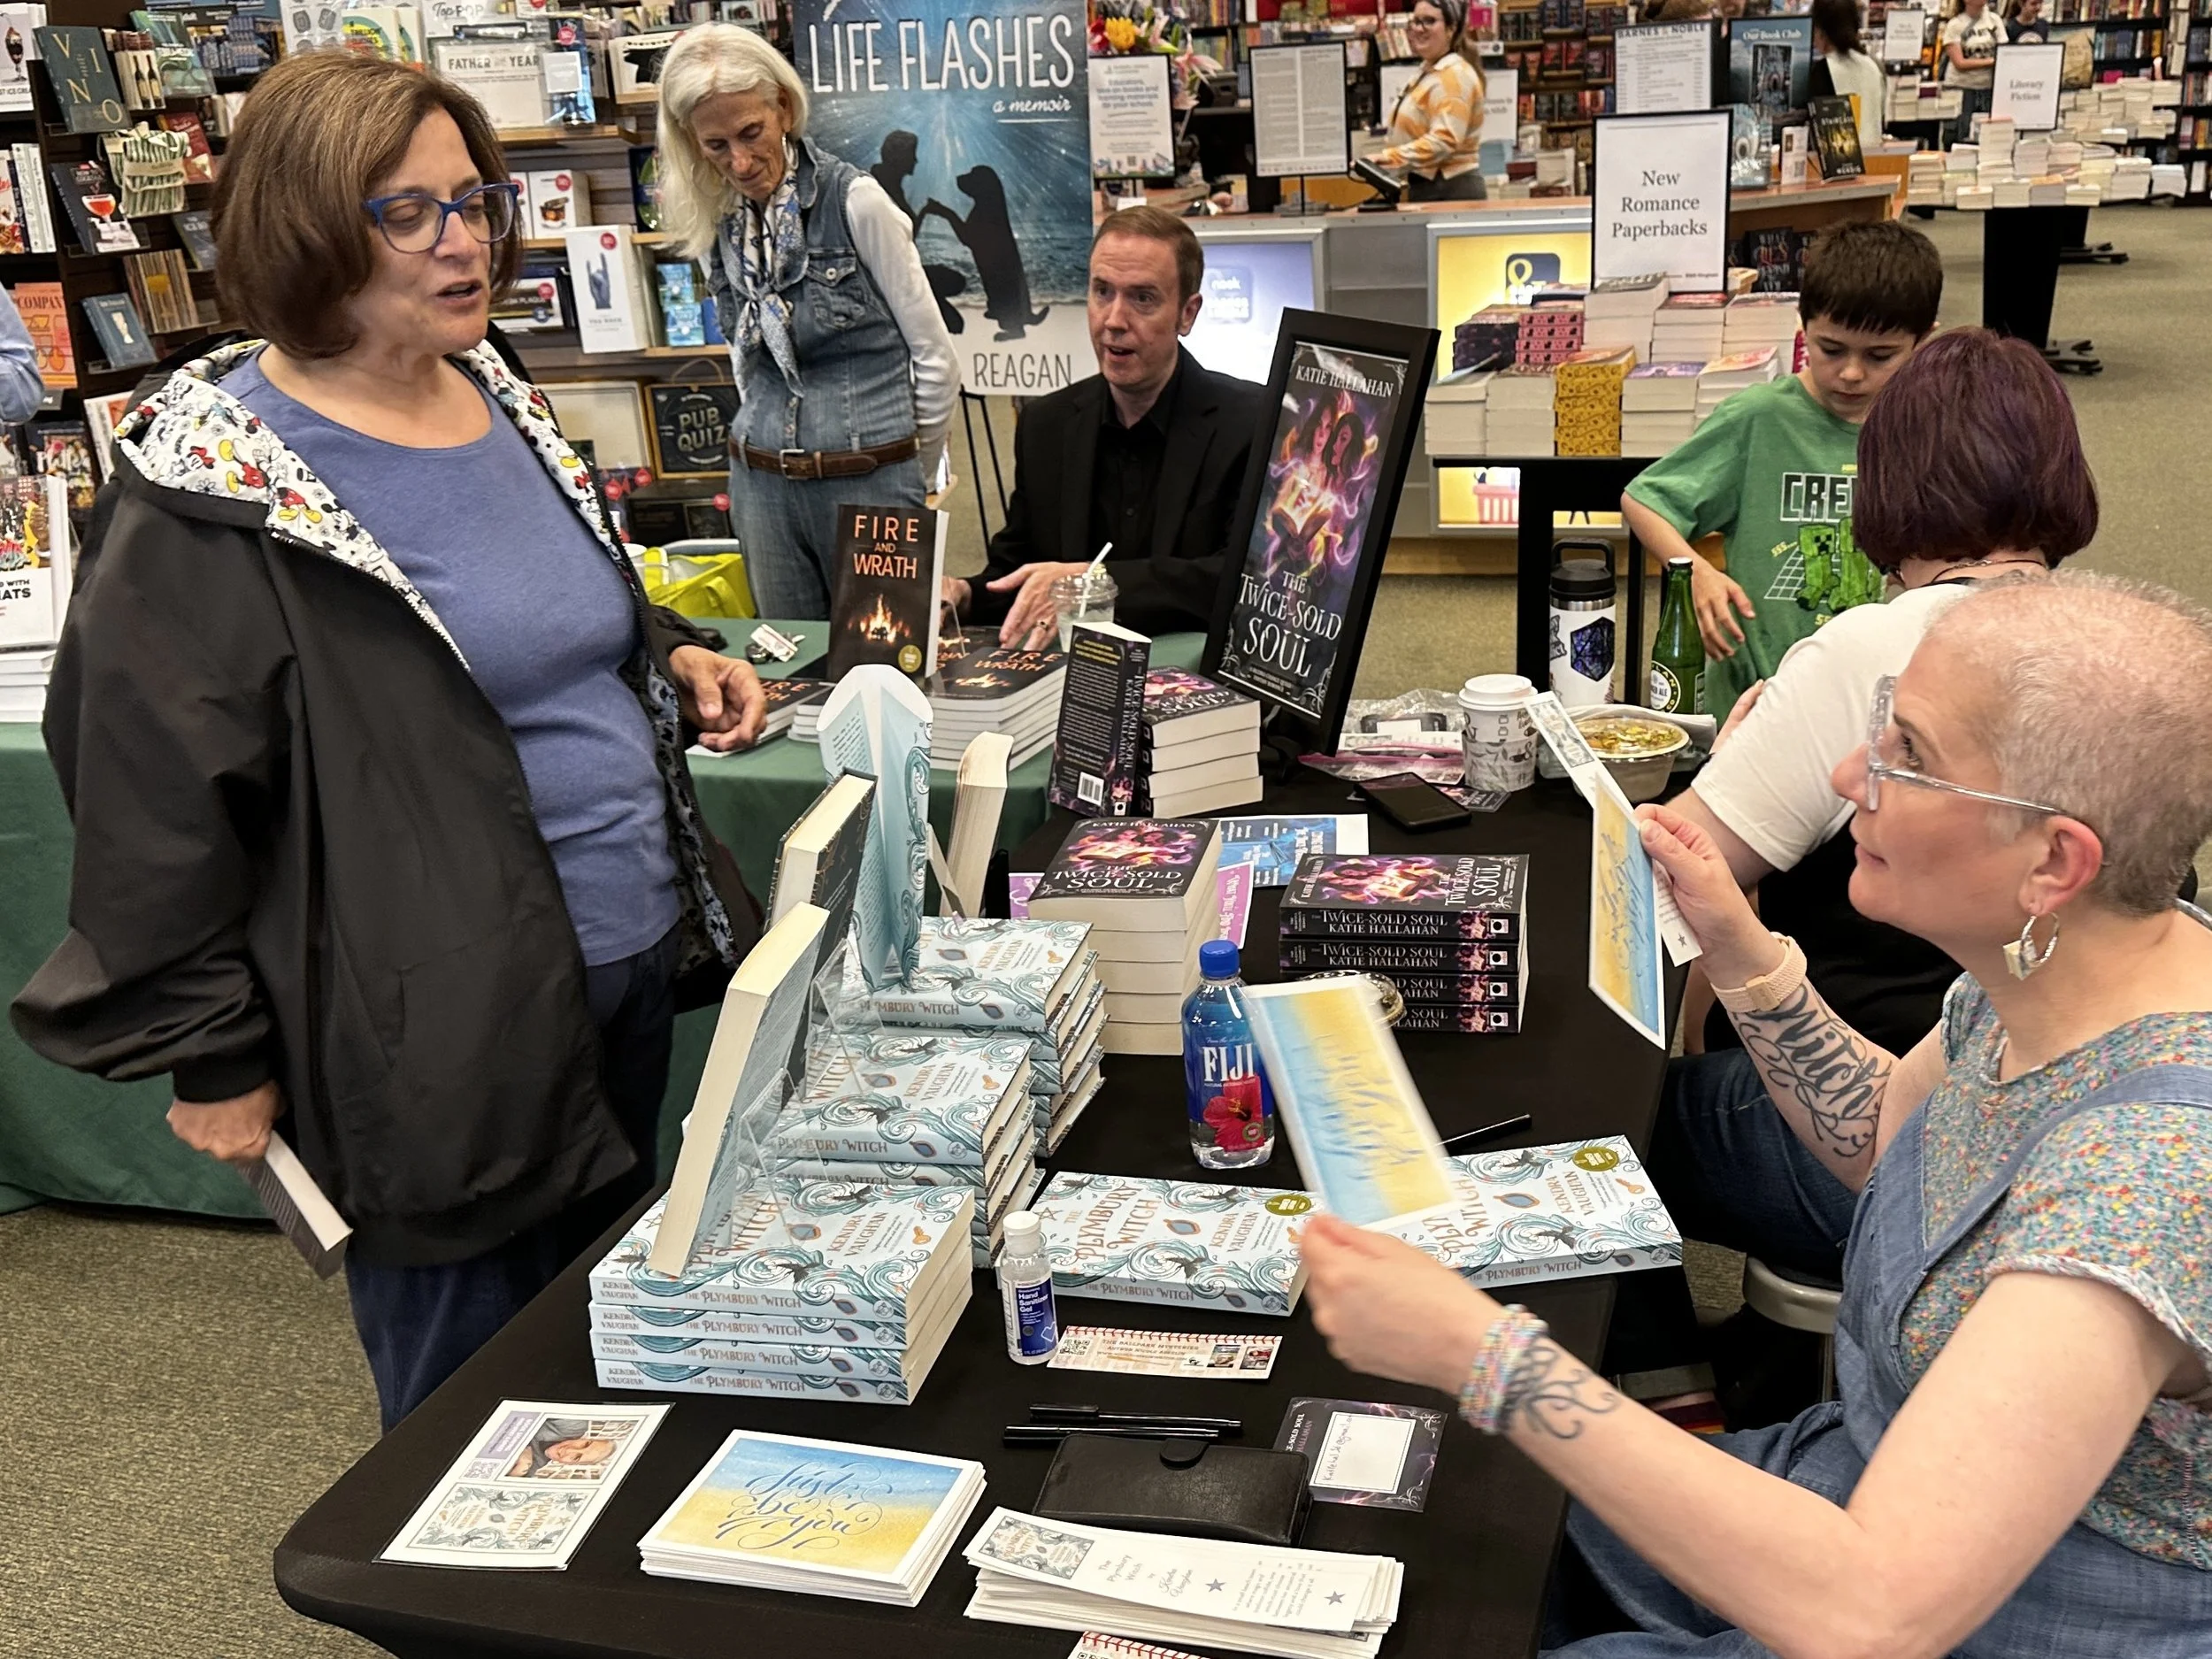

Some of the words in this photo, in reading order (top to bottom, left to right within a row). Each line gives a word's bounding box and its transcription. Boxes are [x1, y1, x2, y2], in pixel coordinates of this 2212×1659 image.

[449, 55, 491, 70] FATHER
[510, 53, 539, 67] YEAR
[809, 21, 889, 93] LIFE
[898, 14, 1075, 91] FLASHES
[1009, 95, 1072, 113] memoir
[1642, 170, 1680, 187] New
[1621, 196, 1700, 213] Romance
[1611, 219, 1708, 242] Paperbacks
[972, 352, 1073, 389] REAGAN
[1295, 365, 1328, 385] KATIE
[1328, 369, 1394, 398] HALLAHAN
[679, 406, 720, 434] PUB
[677, 425, 727, 452] QUIZ
[1780, 472, 1857, 522] CRE
[853, 514, 920, 542] FIRE
[874, 541, 896, 554] AND
[853, 553, 918, 580] WRATH
[7, 578, 30, 587] WITH
[1283, 570, 1308, 594] THE
[988, 650, 1064, 663] FIRE
[1243, 617, 1312, 678] SOUL
[974, 660, 1046, 672] WRATH
[1124, 679, 1133, 708] KATIE
[1118, 710, 1131, 764] HALLAHAN
[1125, 742, 1135, 771] SOUL
[1067, 878, 1154, 889] SOUL
[1439, 872, 1452, 886] THE
[1471, 864, 1502, 897] SOUL
[1301, 881, 1316, 898] KATIE
[1410, 913, 1448, 926] SOUL
[1328, 923, 1365, 934] KATIE
[1369, 924, 1440, 935] HALLAHAN
[1409, 946, 1448, 959] SOUL
[1328, 956, 1365, 966] KATIE
[1369, 956, 1440, 968] HALLAHAN
[1410, 978, 1448, 990] SOUL
[1402, 988, 1440, 999] AHAN
[919, 1000, 960, 1015] WITCH
[1411, 1008, 1448, 1019] SOUL
[1397, 1018, 1440, 1028] LAHAN
[1202, 1043, 1255, 1082] FIJI
[903, 1064, 936, 1099] KENDRA
[920, 1062, 956, 1101] VAUGHAN
[841, 1138, 887, 1153] WITCH
[1545, 1174, 1574, 1214] KENDRA
[1563, 1170, 1595, 1217] VAUGHAN
[715, 1201, 788, 1256] WITCH
[1073, 1185, 1146, 1263] PLYMBURY
[1108, 1196, 1164, 1250] WITCH
[1209, 1212, 1240, 1248] KENDRA
[1227, 1210, 1260, 1252] VAUGHAN
[827, 1213, 866, 1252] KENDRA
[843, 1210, 887, 1256] VAUGHAN
[1485, 1264, 1541, 1281] PLYMBURY
[1543, 1260, 1582, 1274] WITCH
[600, 1290, 639, 1300] VAUGHAN
[602, 1281, 635, 1291] KENDRA
[1100, 1282, 1156, 1298] PLYMBURY
[1156, 1286, 1194, 1302] WITCH
[701, 1290, 759, 1308] PLYMBURY
[759, 1294, 802, 1309] WITCH
[1018, 1291, 1039, 1300] Hand
[1019, 1294, 1049, 1306] Sanitizer
[603, 1311, 636, 1322] KENDRA
[601, 1321, 639, 1331] VAUGHAN
[702, 1319, 761, 1336] PLYMBURY
[761, 1323, 803, 1337] WITCH
[601, 1346, 639, 1356] VAUGHAN
[602, 1337, 636, 1347] KENDRA
[699, 1346, 757, 1362] PLYMBURY
[758, 1350, 799, 1366] WITCH
[605, 1376, 645, 1386] VAUGHAN
[608, 1367, 641, 1377] KENDRA
[705, 1373, 764, 1390] PLYMBURY
[765, 1378, 805, 1393] WITCH
